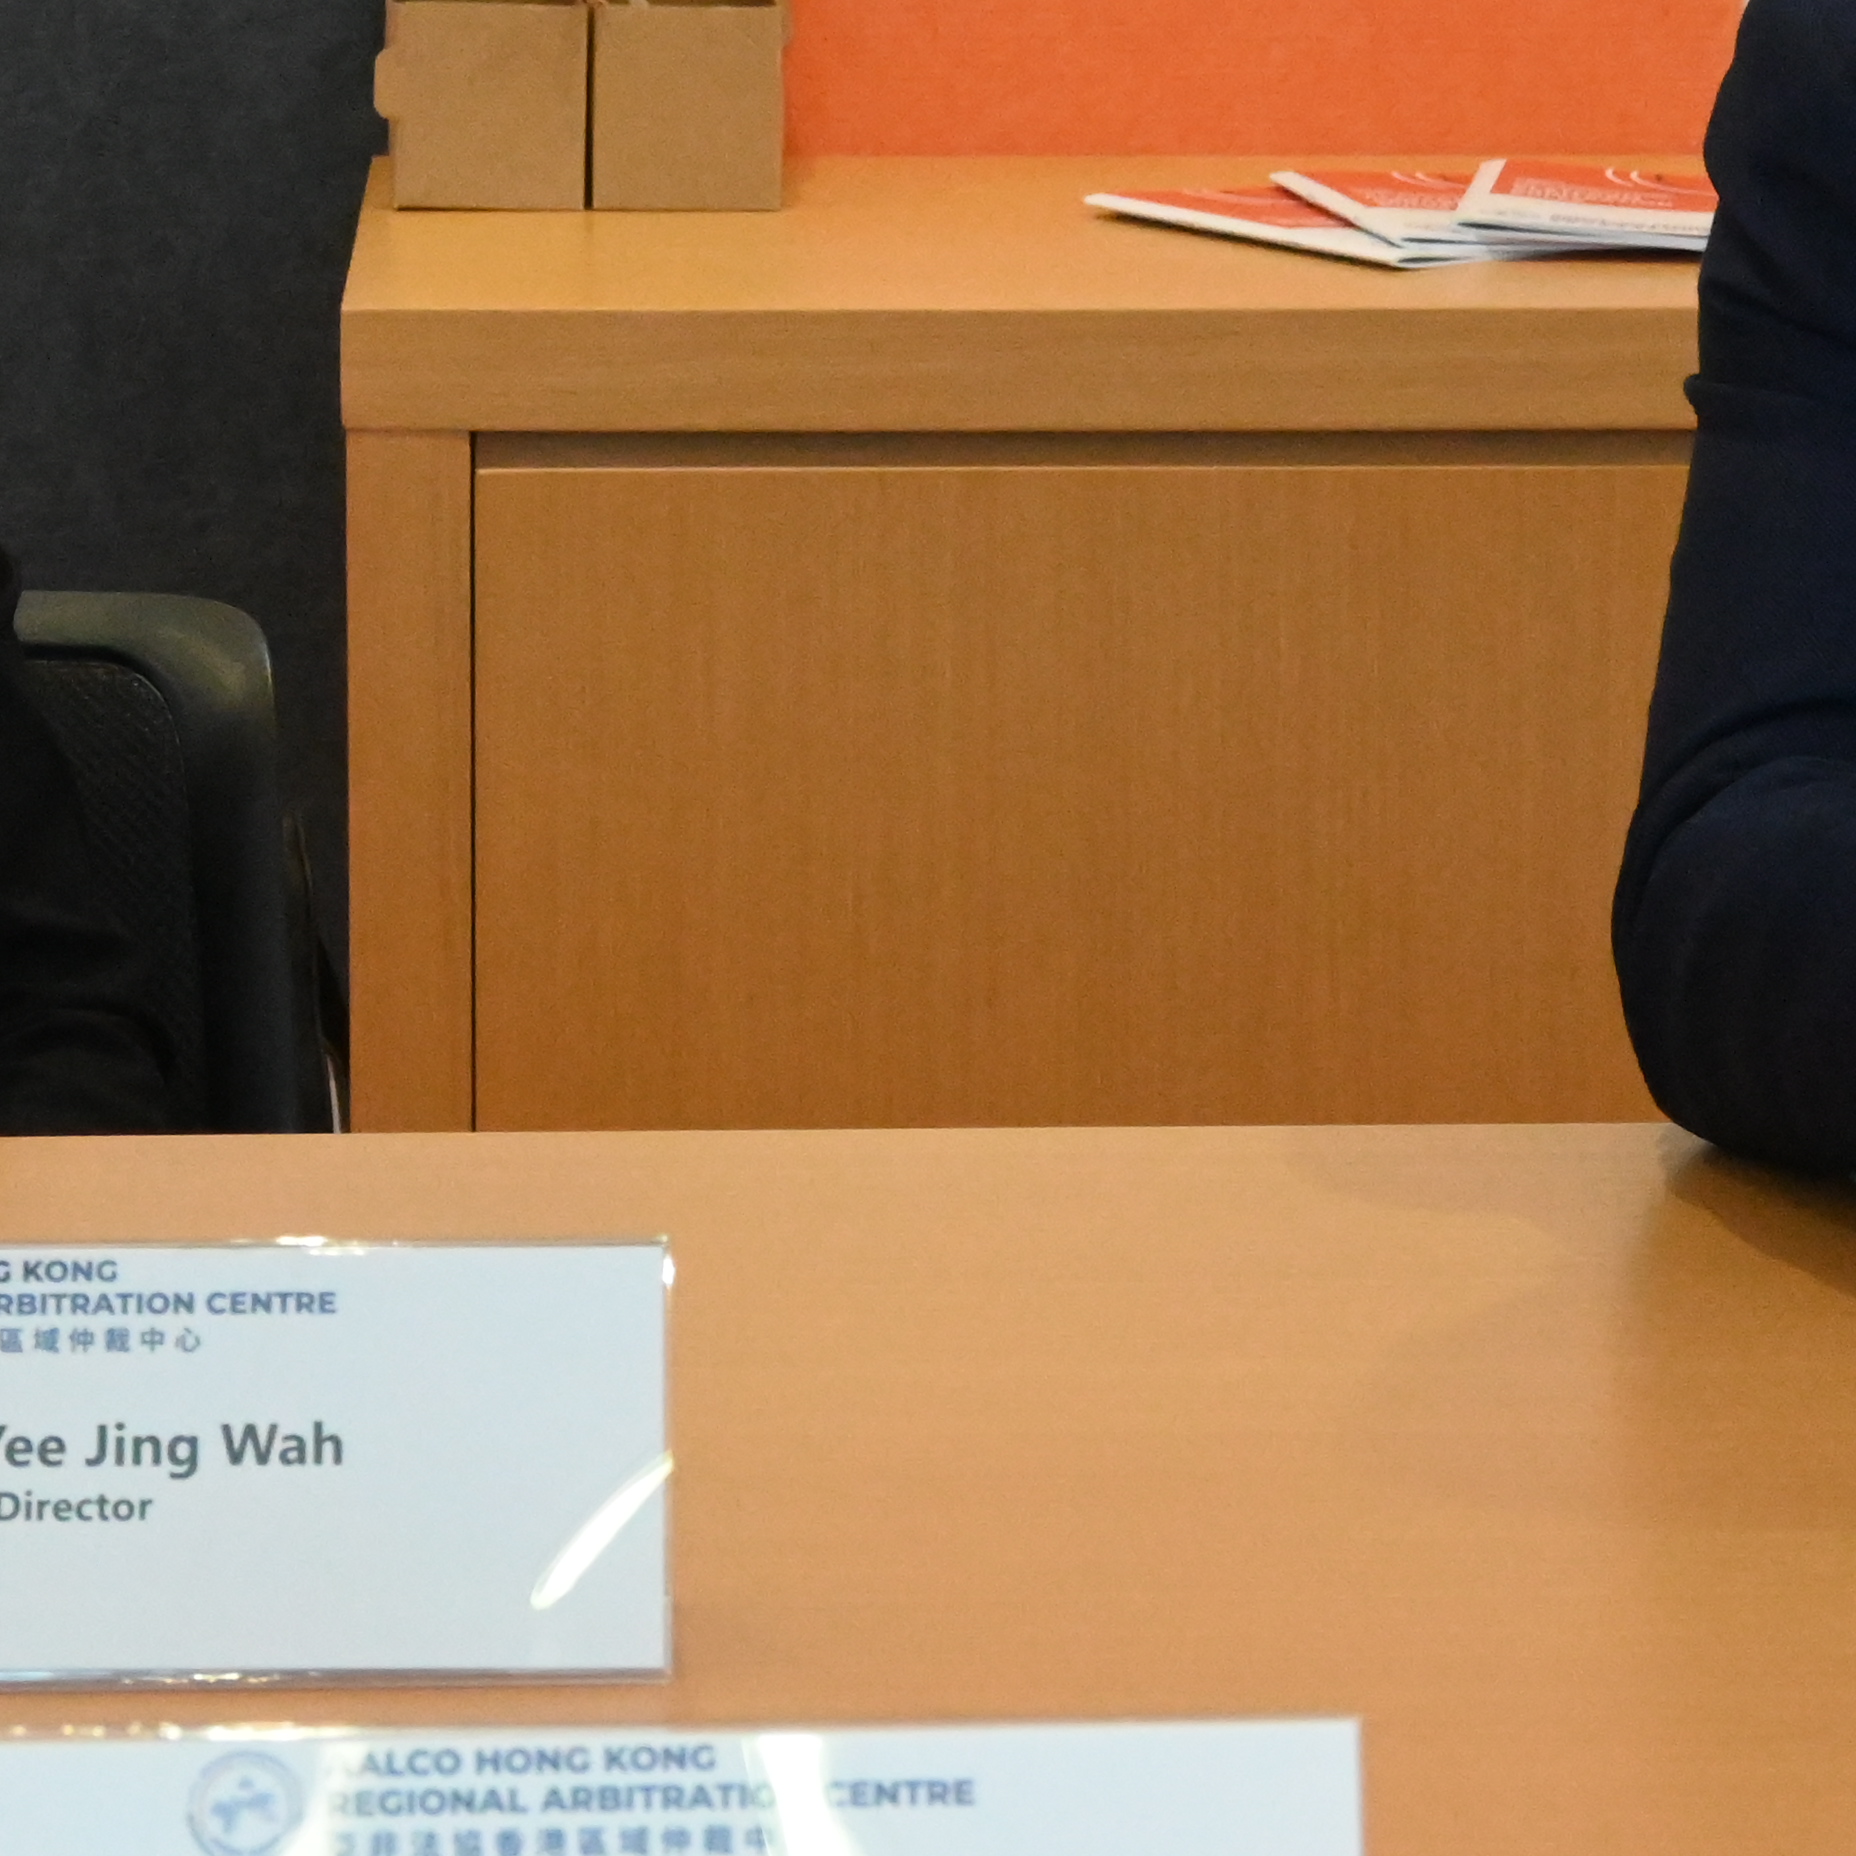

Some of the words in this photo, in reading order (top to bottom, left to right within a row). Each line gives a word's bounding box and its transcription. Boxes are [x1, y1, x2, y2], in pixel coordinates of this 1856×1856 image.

[22, 1259, 117, 1283] KONG
[205, 1290, 337, 1316] CENTRE
[84, 1421, 199, 1481] Jing
[220, 1419, 344, 1468] Wah
[342, 1747, 463, 1778] ALCO
[474, 1746, 591, 1775] HONG
[603, 1743, 717, 1773] KONG
[540, 1781, 777, 1814] ARBITRATIO
